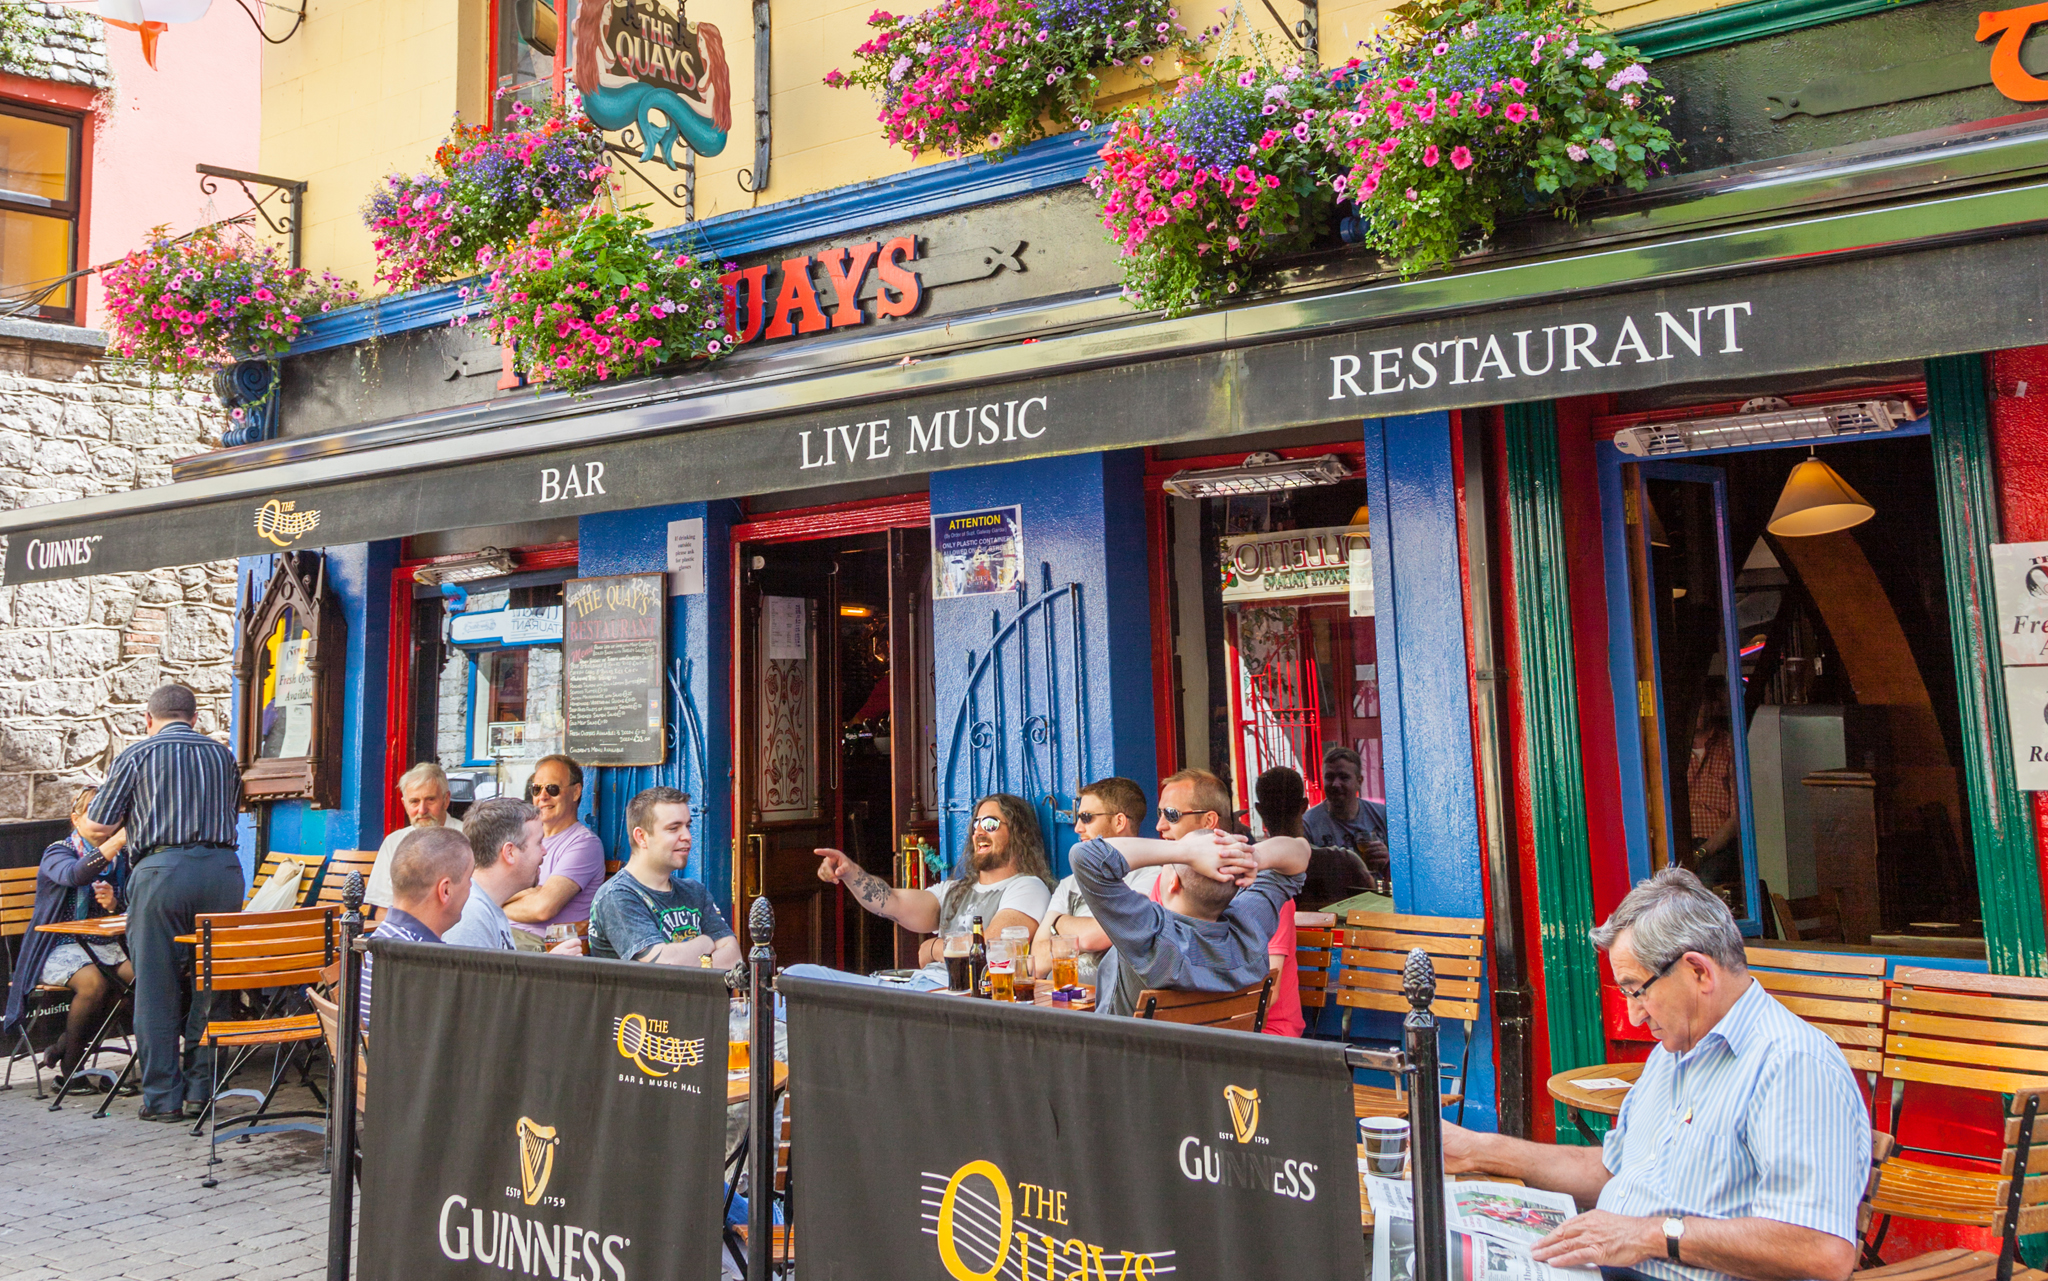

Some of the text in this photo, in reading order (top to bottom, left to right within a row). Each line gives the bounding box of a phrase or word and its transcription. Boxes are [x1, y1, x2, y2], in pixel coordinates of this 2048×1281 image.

[638, 12, 674, 48] THE
[615, 30, 697, 91] QUAYS
[720, 234, 921, 345] UAYS
[1328, 301, 1751, 400] RESTAURANT
[798, 396, 1047, 470] LIVE MUSIC
[539, 461, 606, 503] BAR
[281, 500, 296, 511] THE
[949, 514, 1001, 530] ATTENTION
[943, 548, 968, 556] ALLOWED
[574, 585, 651, 618] THE QUAY'S
[570, 617, 657, 640] RESTAURANT
[279, 672, 313, 686] Fresh Oys
[648, 1019, 669, 1033] THE
[617, 1012, 698, 1077] Quays
[618, 1073, 702, 1094] BAR & MUSIC HALL
[1254, 1136, 1270, 1145] 1759
[543, 1196, 566, 1207] 1759
[1019, 1182, 1068, 1225] THE
[438, 1194, 627, 1281] GUINNESS
